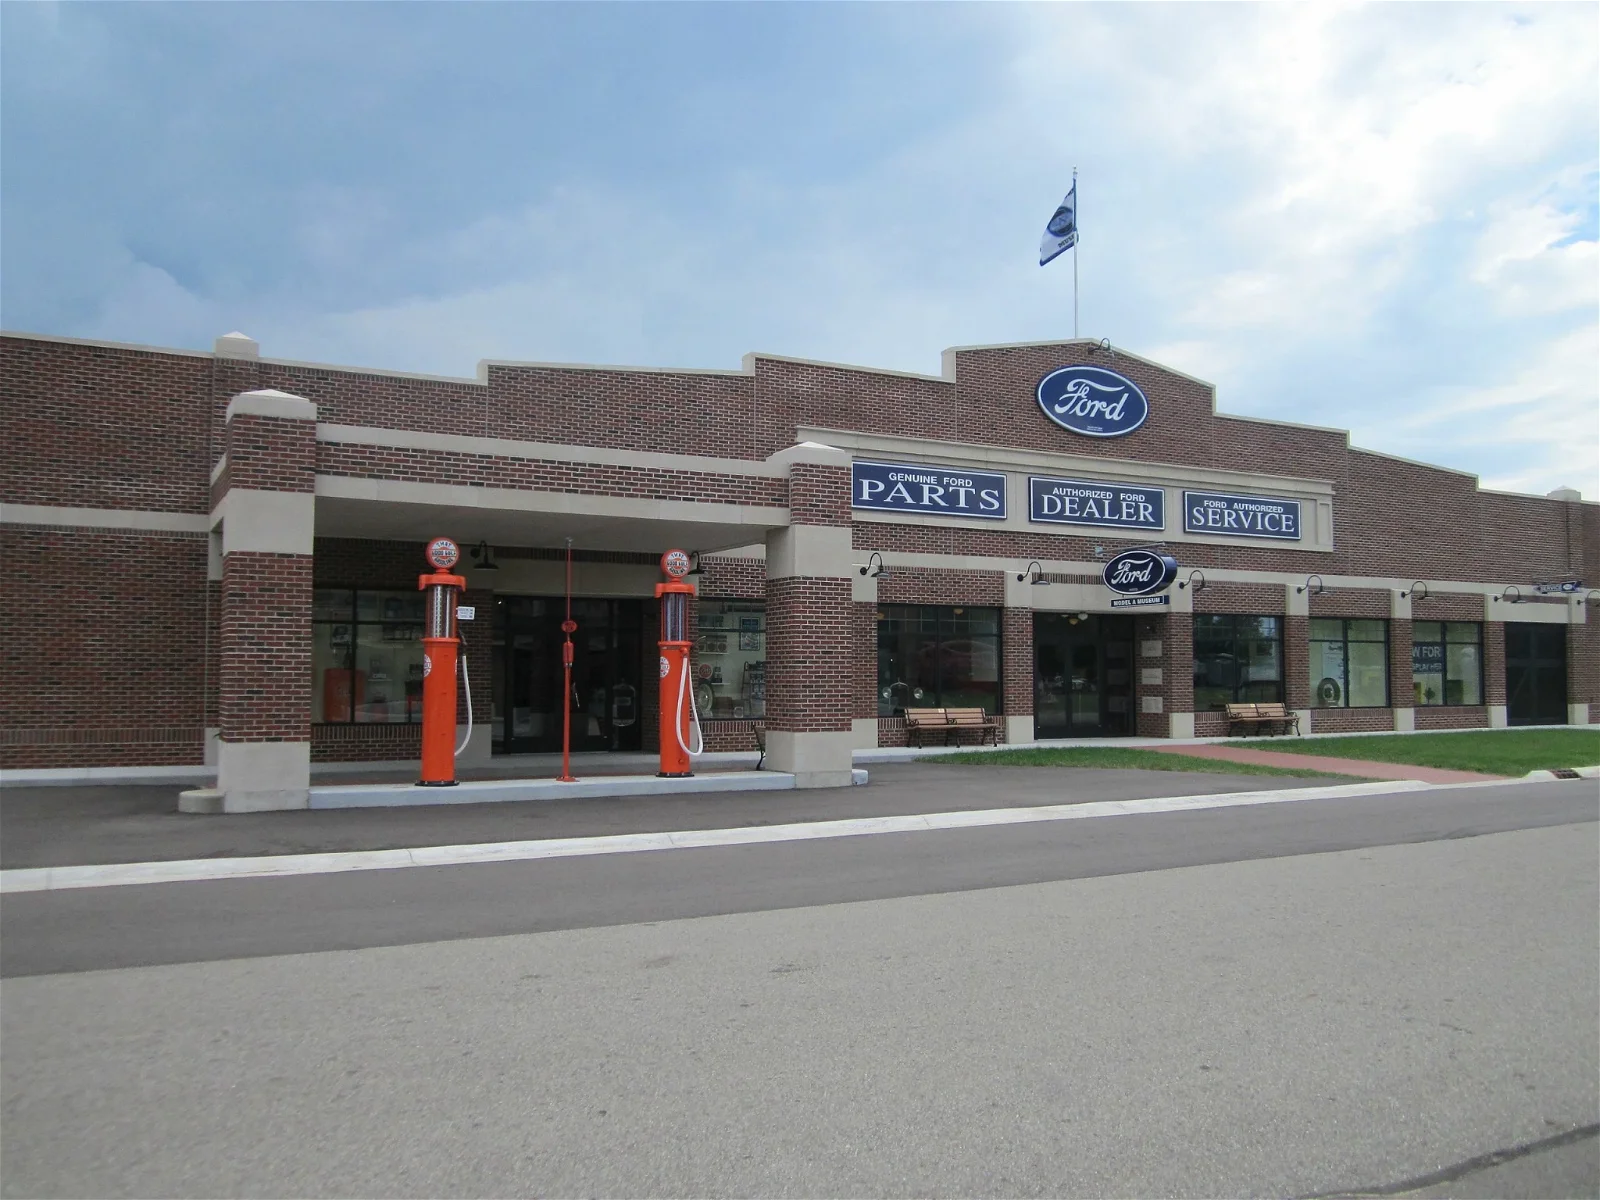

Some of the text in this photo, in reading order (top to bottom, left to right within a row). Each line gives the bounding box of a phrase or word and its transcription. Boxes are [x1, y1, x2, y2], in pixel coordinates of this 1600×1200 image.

[1054, 379, 1129, 421] Ford
[888, 472, 973, 487] GENUINE FORD
[858, 478, 1000, 510] PARTS
[1052, 487, 1145, 502] AUTHORIZED FORD
[1041, 494, 1156, 522] DEALER
[1203, 500, 1284, 513] FORD AUTHORIZED
[1192, 506, 1295, 532] SERVICE
[1111, 558, 1153, 584] Ford
[1137, 597, 1160, 605] MUSEUM
[1422, 646, 1441, 658] FOR
